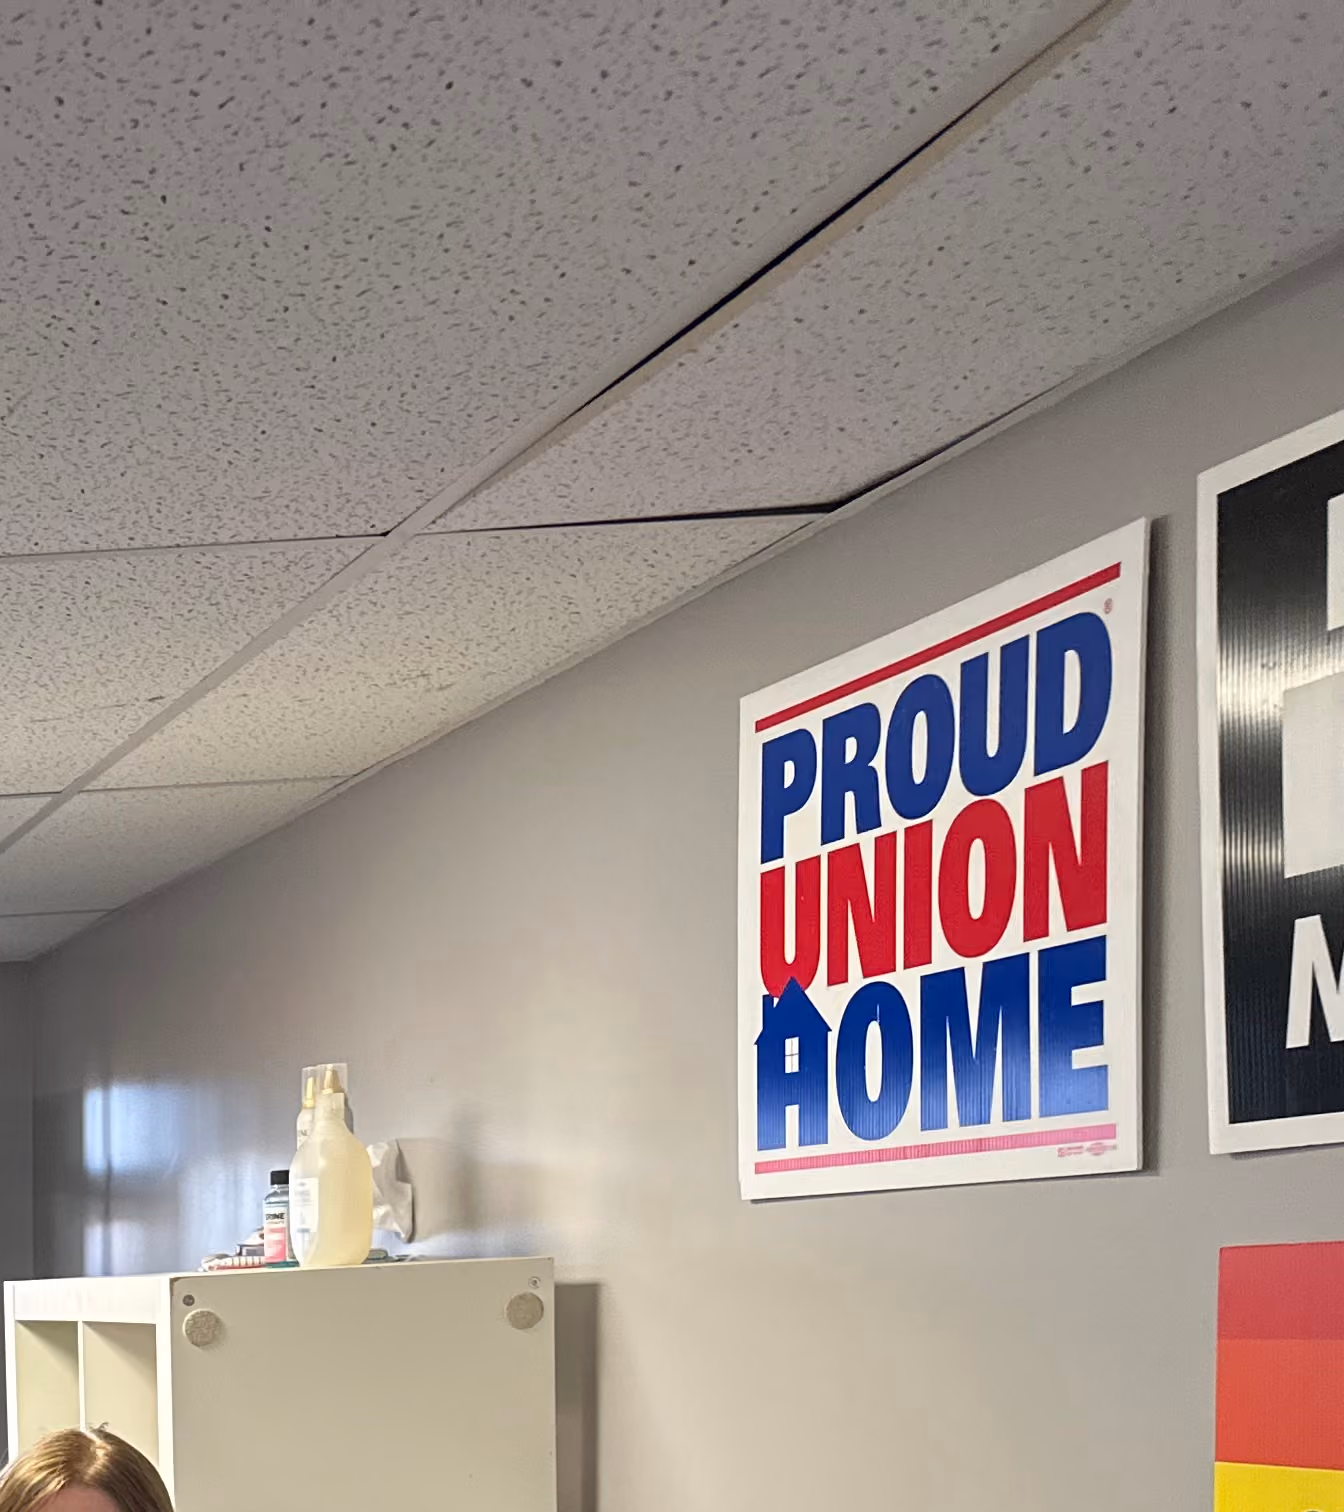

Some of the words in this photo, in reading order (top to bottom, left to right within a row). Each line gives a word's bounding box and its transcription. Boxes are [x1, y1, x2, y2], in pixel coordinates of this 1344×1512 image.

[760, 611, 1113, 866] PROUD
[760, 760, 1109, 1000] UNION
[754, 935, 1109, 1152] HOME
